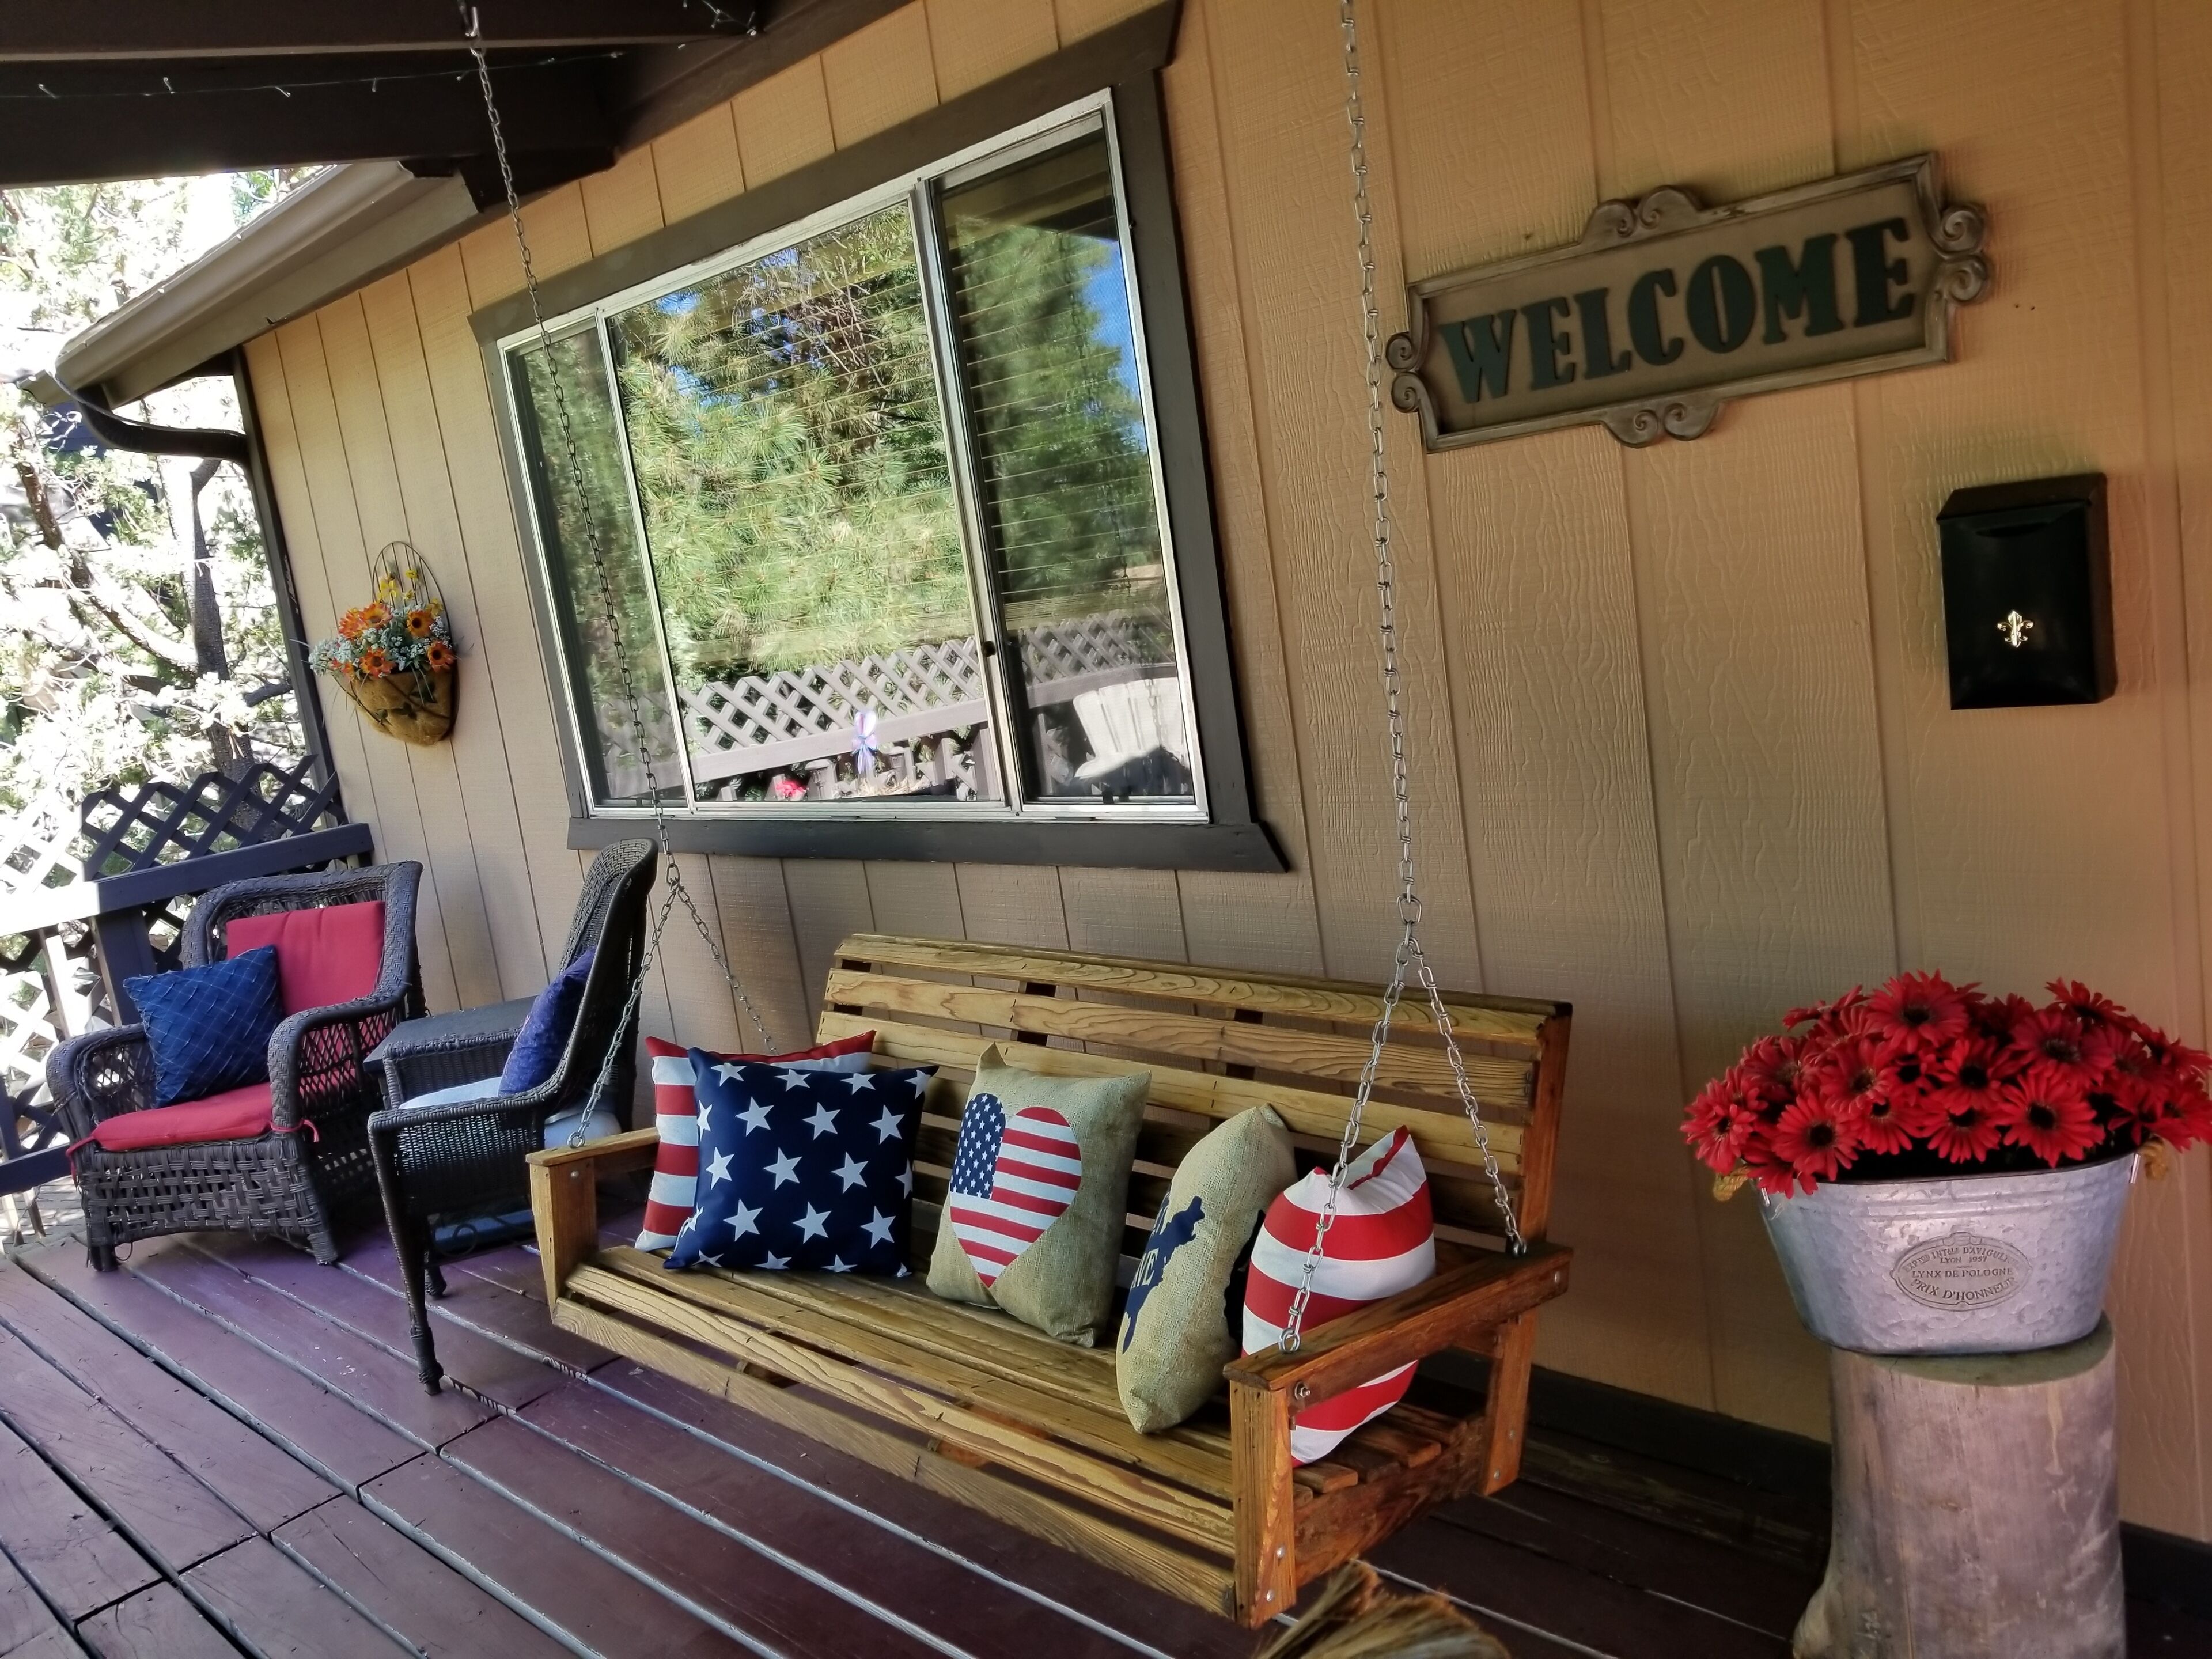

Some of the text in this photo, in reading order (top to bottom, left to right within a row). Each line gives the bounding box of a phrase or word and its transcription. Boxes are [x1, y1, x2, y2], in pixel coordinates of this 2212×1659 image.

[1437, 217, 1918, 404] WELCOME
[1962, 1268, 2013, 1277] POLOGNE
[1910, 1277, 2018, 1301] PRIX D'HONNEUR
